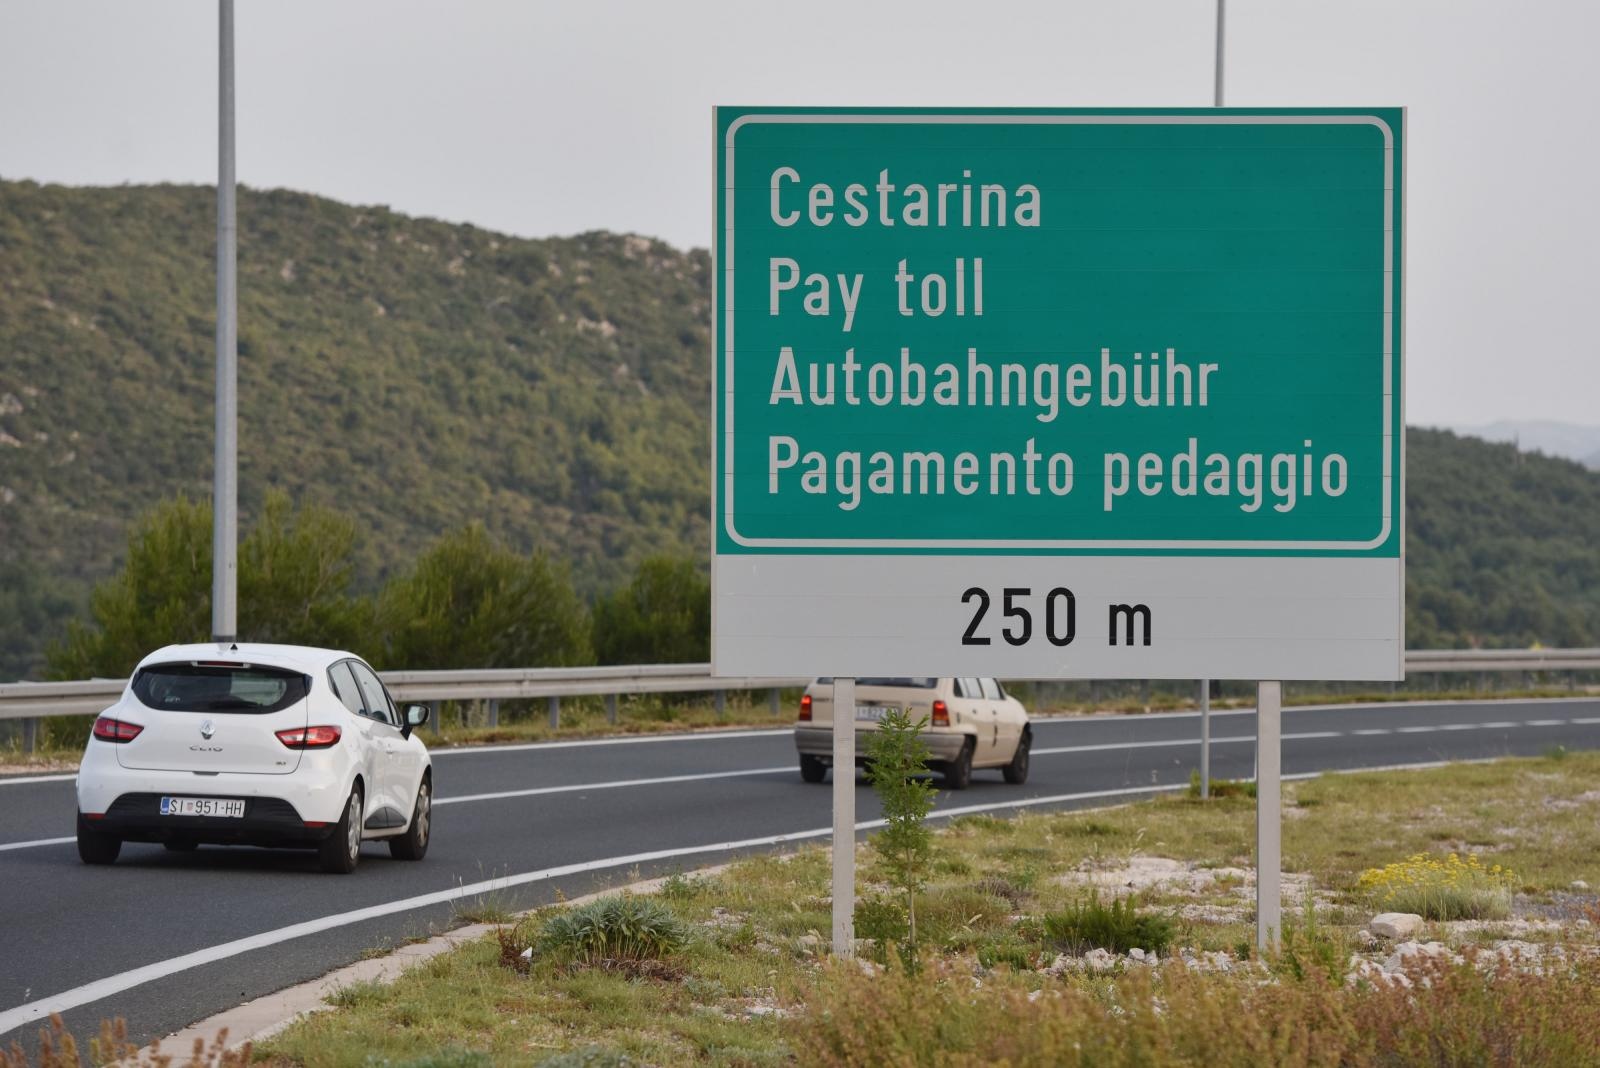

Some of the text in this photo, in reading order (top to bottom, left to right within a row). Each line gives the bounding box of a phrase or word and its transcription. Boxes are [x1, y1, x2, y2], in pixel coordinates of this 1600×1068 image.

[770, 167, 1041, 227] Cestarina
[769, 257, 983, 332] Pay toll
[769, 346, 1219, 423] Autobahngebühr
[768, 436, 1348, 513] Pagamento pedaggio
[960, 586, 1152, 647] 250 m
[195, 800, 242, 815] 951-HH
